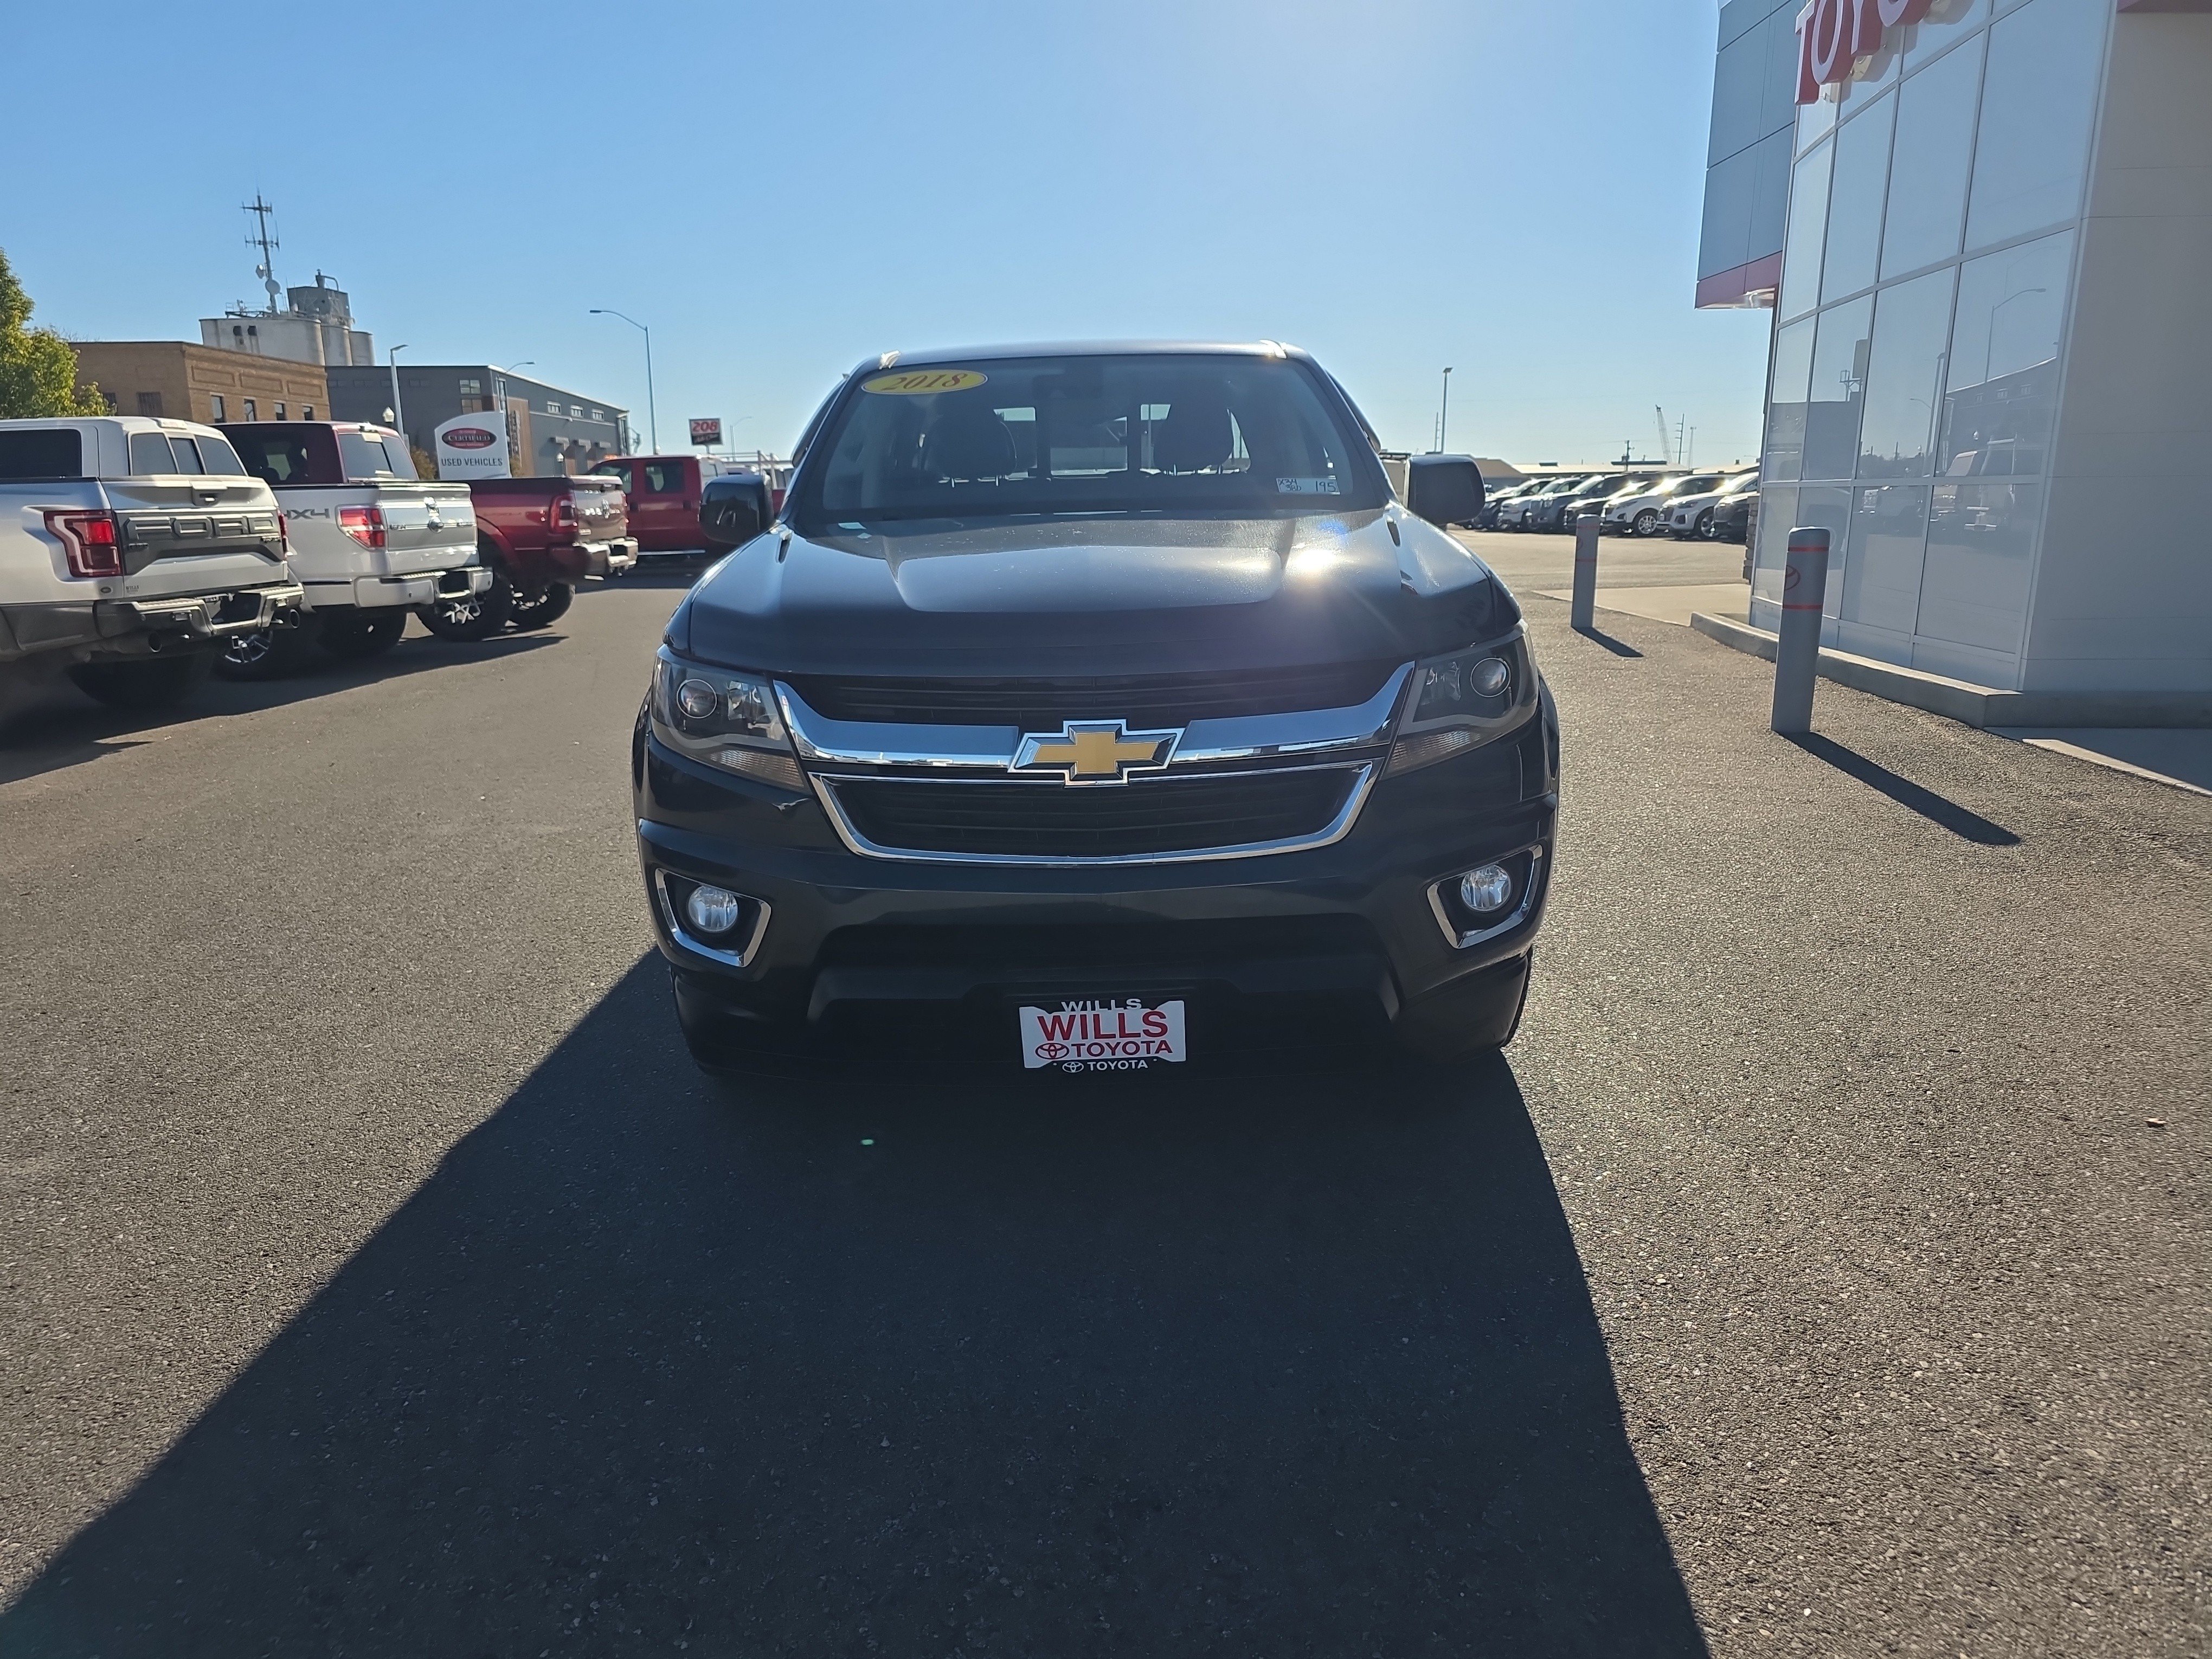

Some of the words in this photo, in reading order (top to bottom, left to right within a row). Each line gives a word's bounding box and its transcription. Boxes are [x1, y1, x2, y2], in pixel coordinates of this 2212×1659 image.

[880, 372, 968, 391] 2018
[441, 458, 461, 467] USED
[464, 458, 503, 467] VEHICLES
[1315, 480, 1336, 492] 195
[124, 512, 279, 541] FORD
[1061, 998, 1142, 1012] WILLS
[1037, 1011, 1168, 1041] WILLS
[1071, 1040, 1173, 1058] TOYOTA
[1087, 1059, 1148, 1071] TOYOTA
